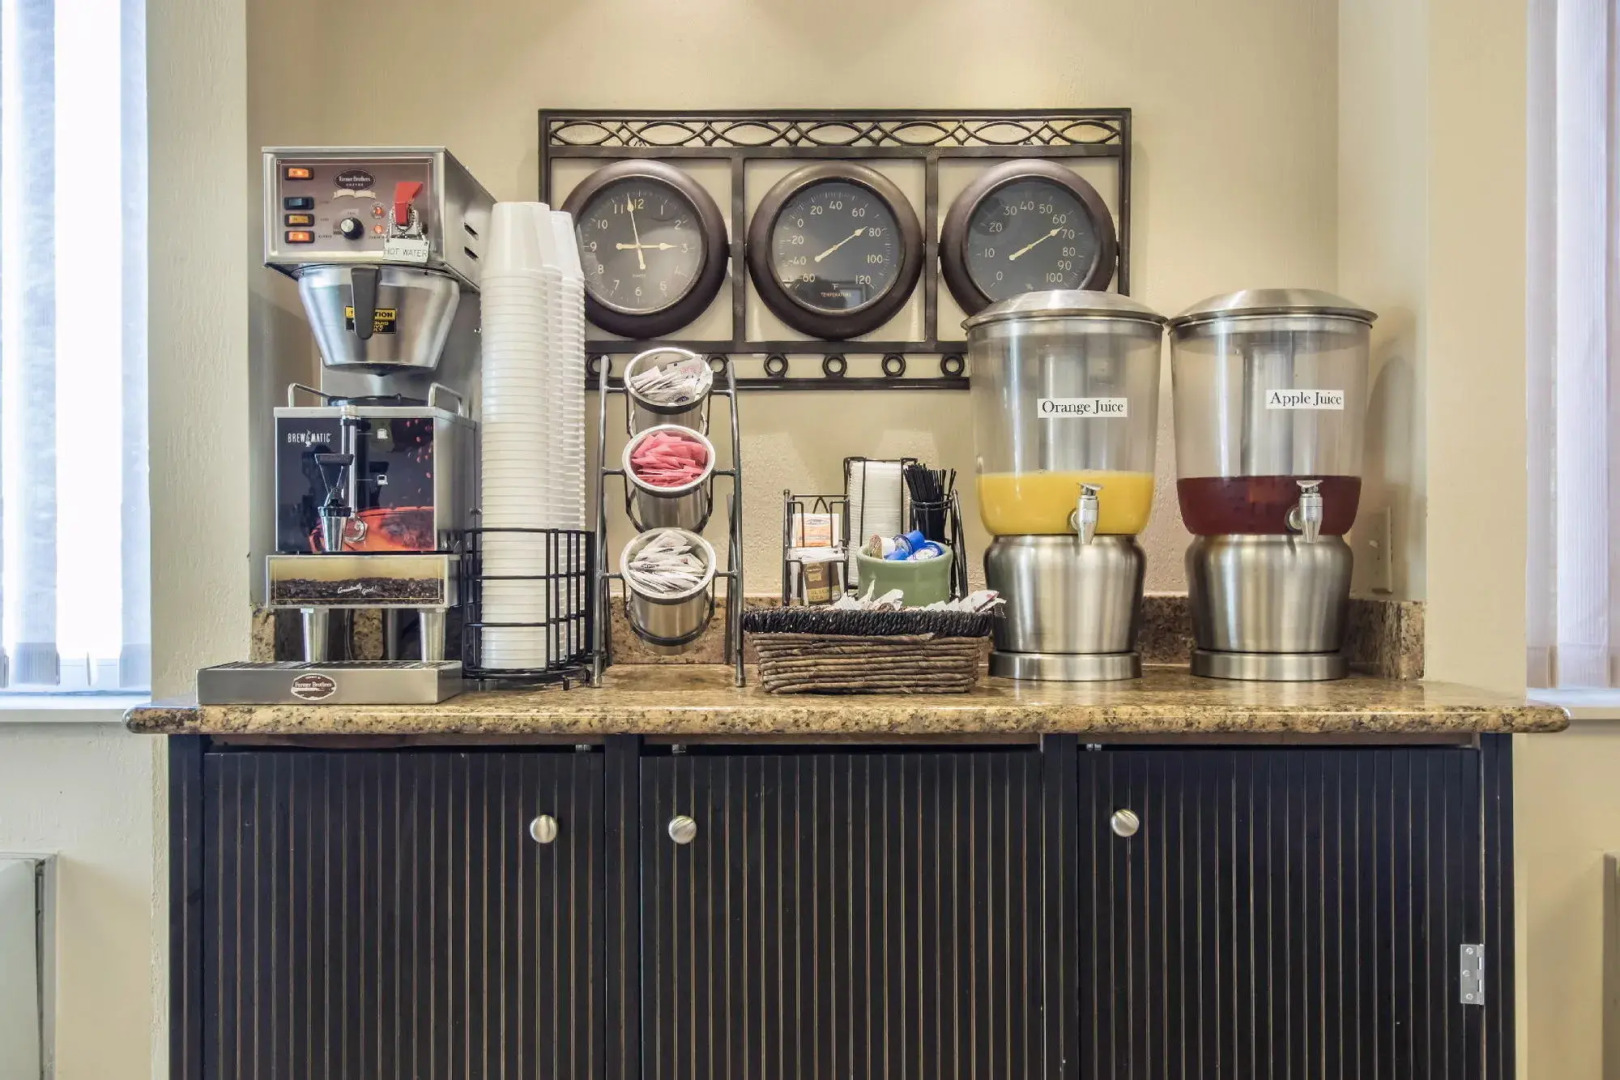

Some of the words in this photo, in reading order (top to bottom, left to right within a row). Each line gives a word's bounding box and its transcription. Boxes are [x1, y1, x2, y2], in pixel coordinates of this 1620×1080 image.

[634, 198, 644, 210] 12
[829, 201, 843, 210] 40
[1020, 201, 1034, 211] 40
[1039, 204, 1053, 214] 50
[614, 204, 624, 215] 11
[659, 204, 664, 215] 1
[810, 205, 823, 215] 20
[852, 207, 865, 218] 60
[1003, 206, 1017, 216] 30
[597, 219, 609, 230] 10
[797, 218, 804, 228] 0
[1052, 214, 1066, 225] 60
[674, 220, 682, 230] 2
[989, 222, 1002, 233] 20
[868, 227, 881, 237] 80
[1062, 229, 1075, 240] 70
[590, 241, 597, 252] 9
[402, 249, 428, 258] WATER
[984, 248, 995, 258] 10
[1062, 247, 1076, 257] 80
[866, 254, 883, 264] 100
[597, 264, 605, 274] 8
[1057, 260, 1072, 271] 90
[855, 275, 871, 285] 120
[996, 271, 1003, 281] 0
[1046, 272, 1063, 283] 100
[614, 280, 620, 290] 7
[634, 286, 642, 297] 6
[1270, 392, 1311, 406] Apple
[1313, 392, 1342, 406] Juice
[1042, 400, 1091, 415] Orange
[1093, 399, 1124, 414] Juice
